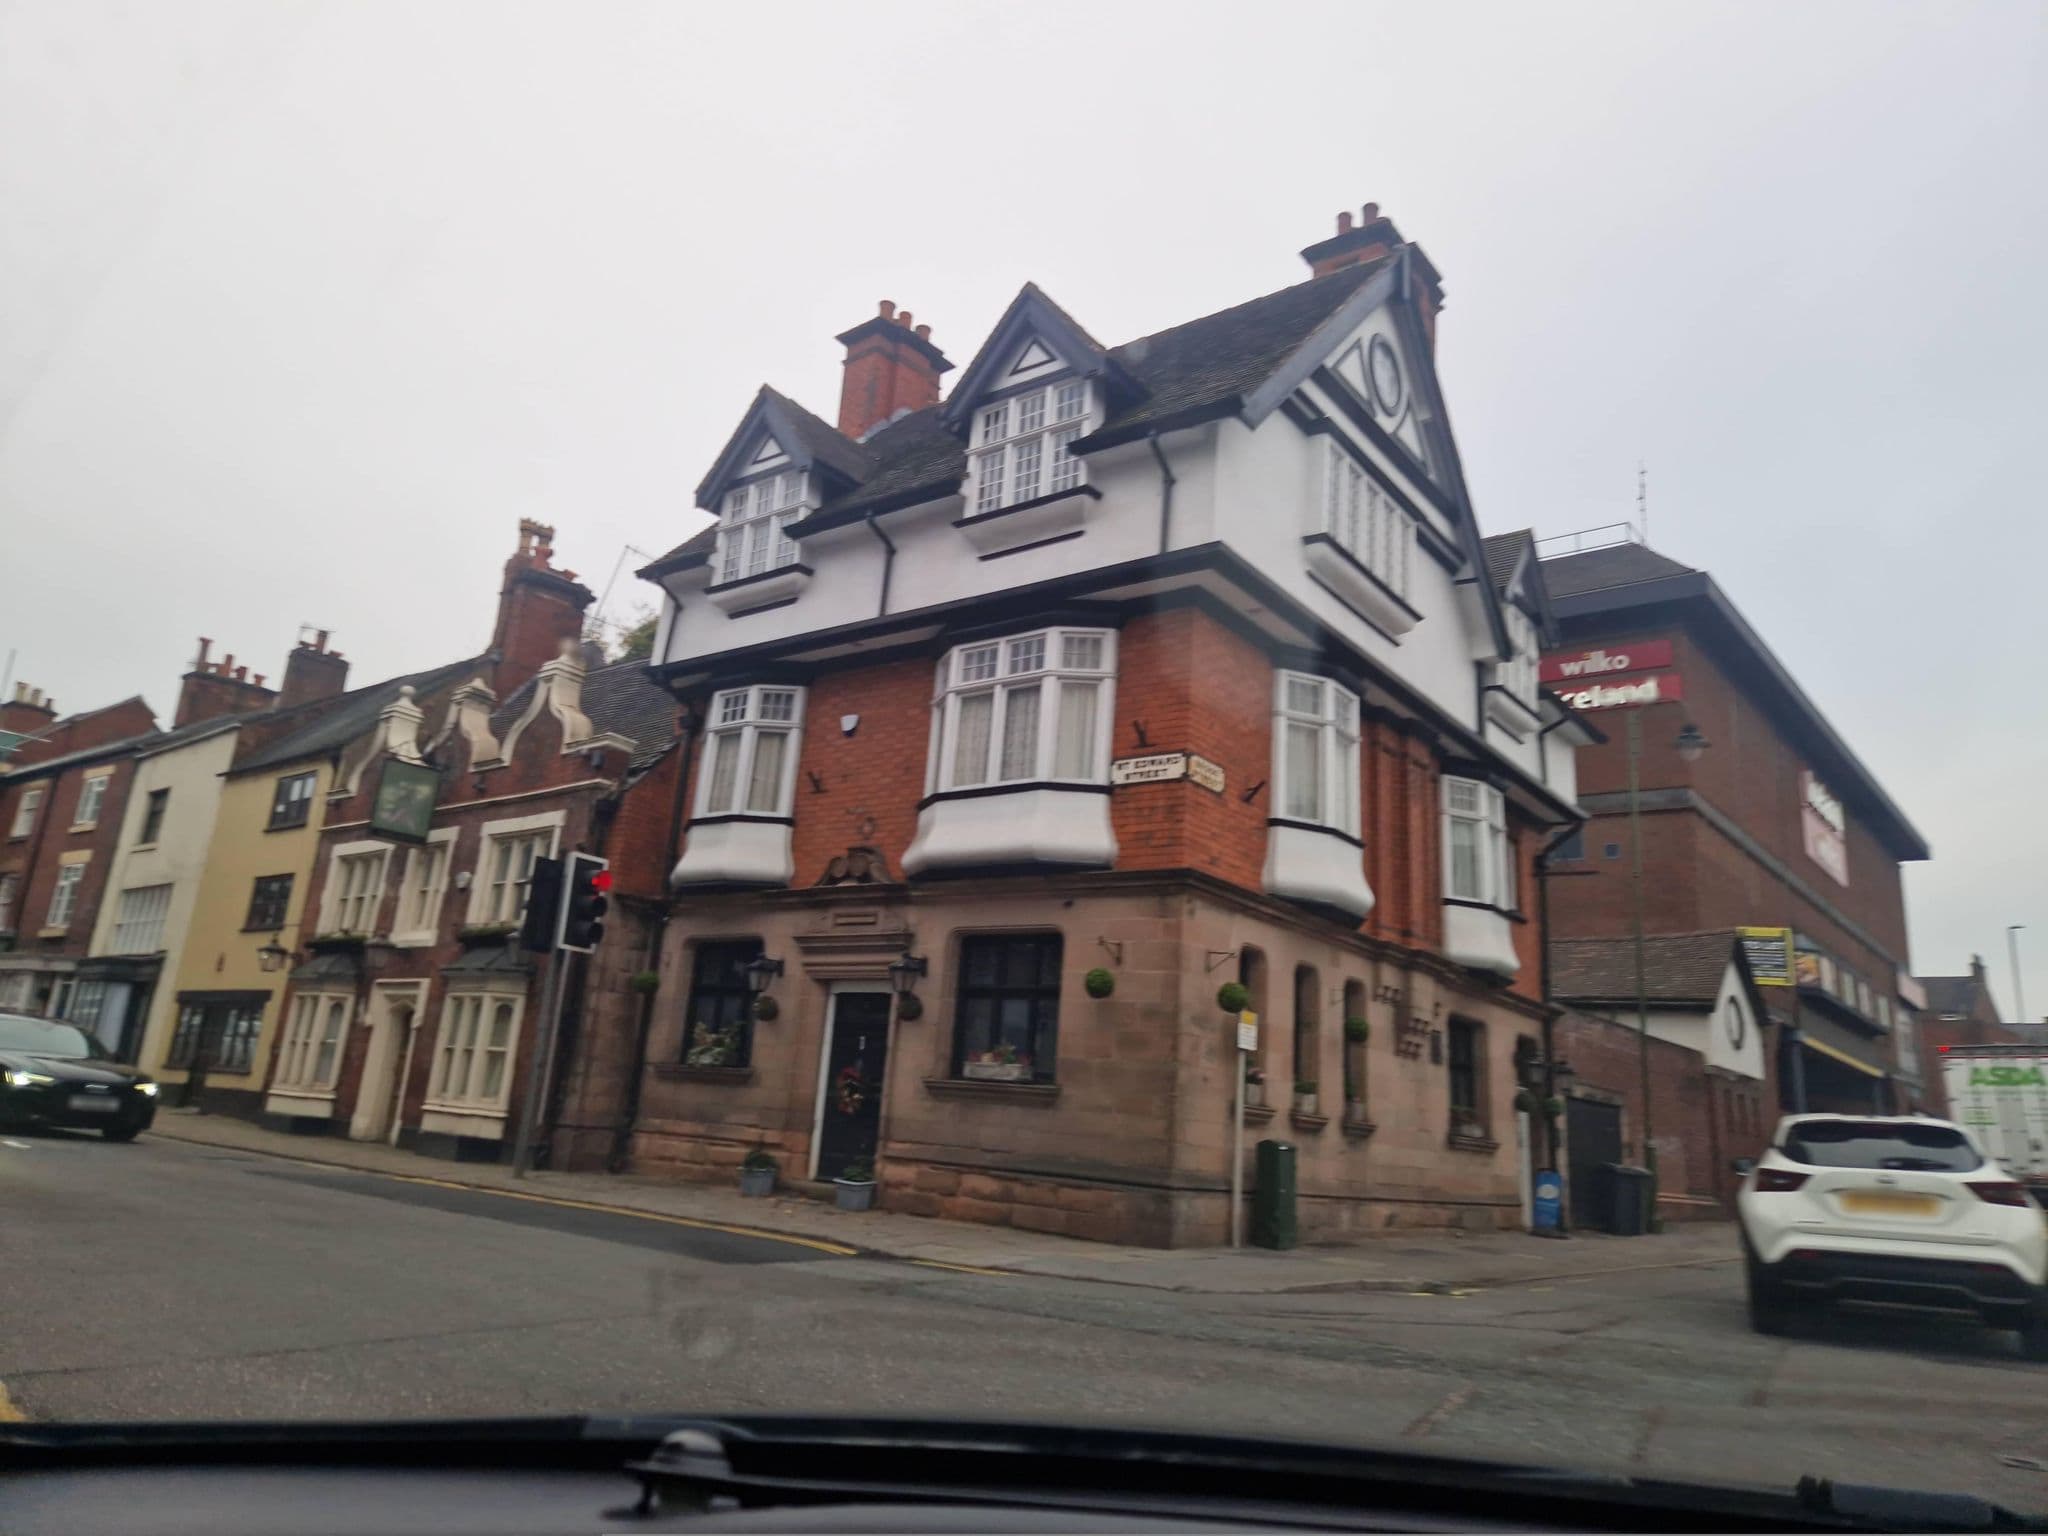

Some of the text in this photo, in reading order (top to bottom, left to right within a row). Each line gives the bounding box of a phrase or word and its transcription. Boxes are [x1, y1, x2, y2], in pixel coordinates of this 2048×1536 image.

[1560, 650, 1630, 676] wilko
[1124, 768, 1169, 780] STREET
[1968, 1066, 2046, 1087] ASDA
